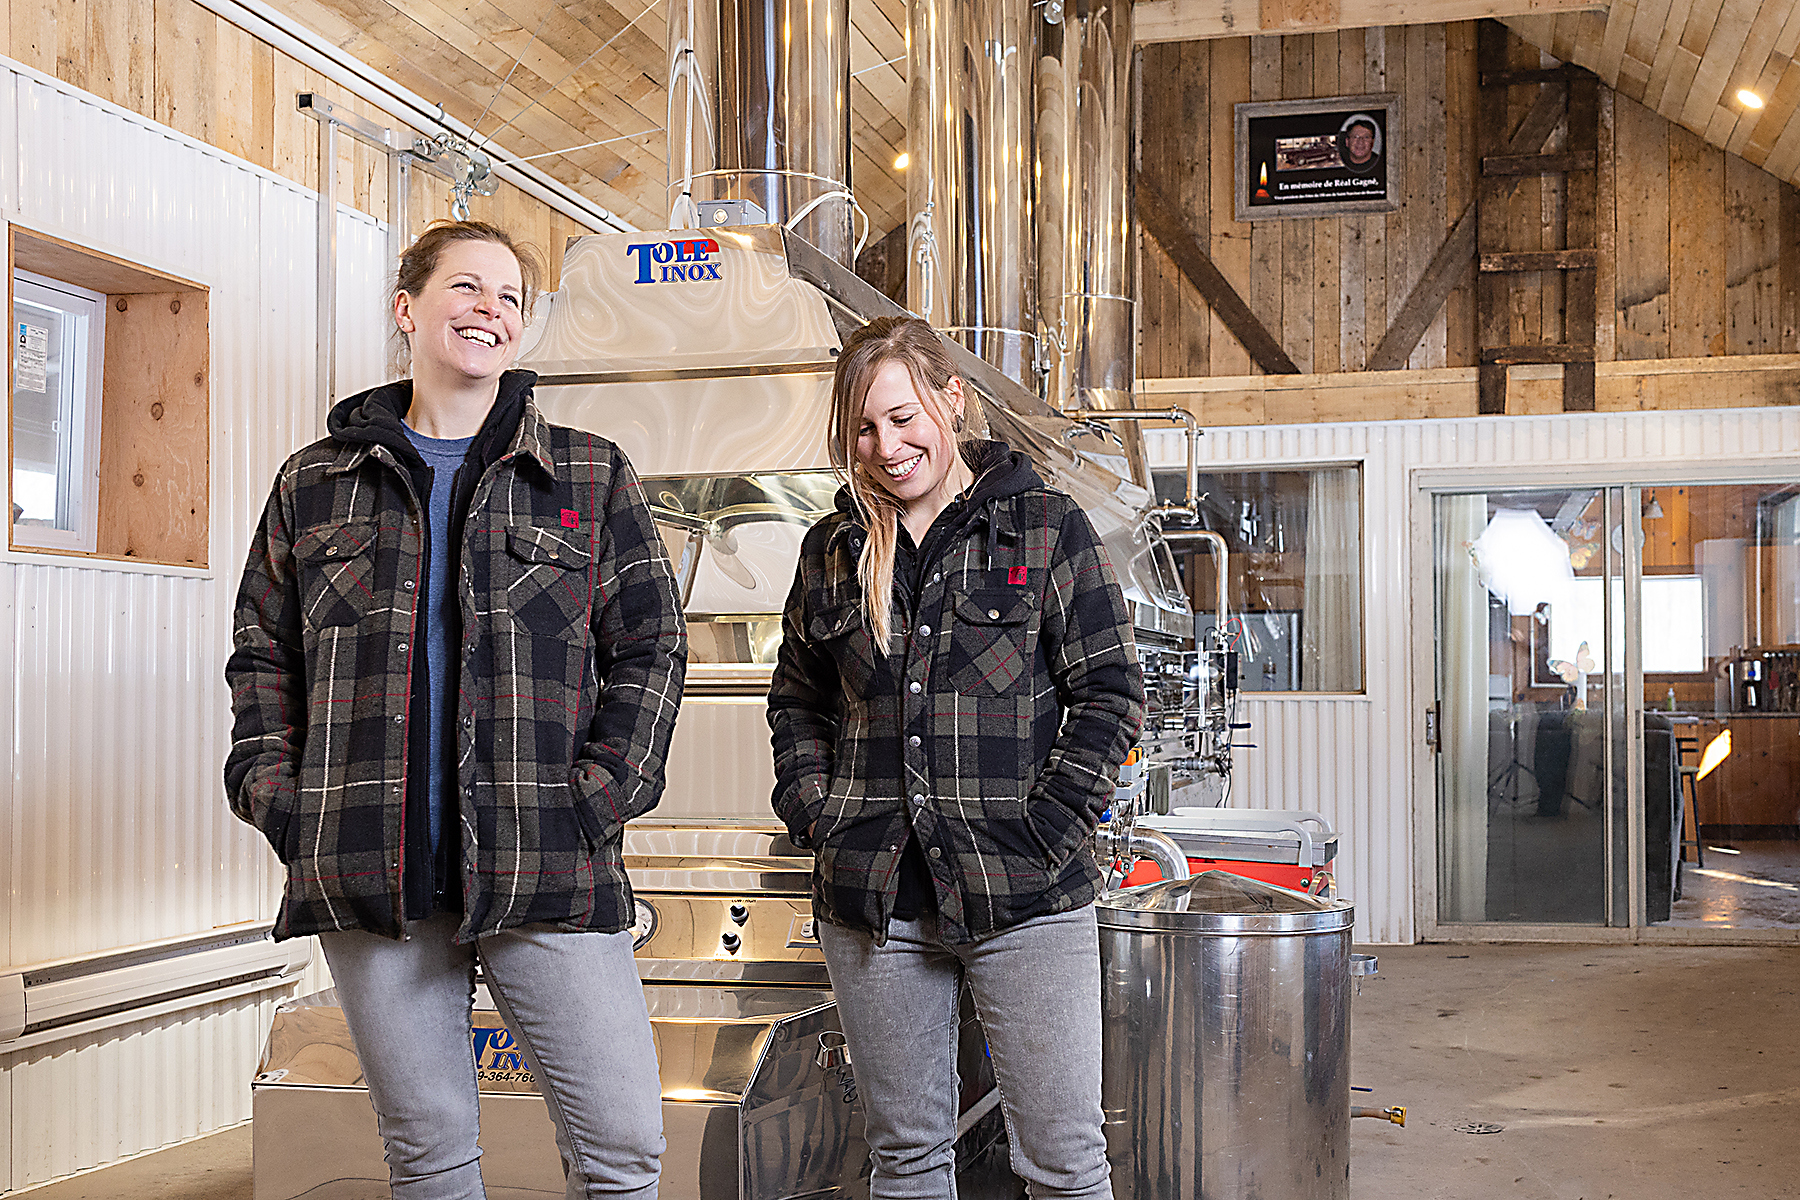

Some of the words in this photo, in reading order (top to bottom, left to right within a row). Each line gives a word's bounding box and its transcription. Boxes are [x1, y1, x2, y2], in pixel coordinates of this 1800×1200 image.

[1290, 180, 1322, 189] mémoire
[1323, 180, 1333, 188] de
[1334, 178, 1351, 187] Réal
[626, 241, 709, 284] TOLE
[659, 262, 723, 283] INOX
[471, 1028, 519, 1070] TO
[487, 1051, 530, 1071] IN
